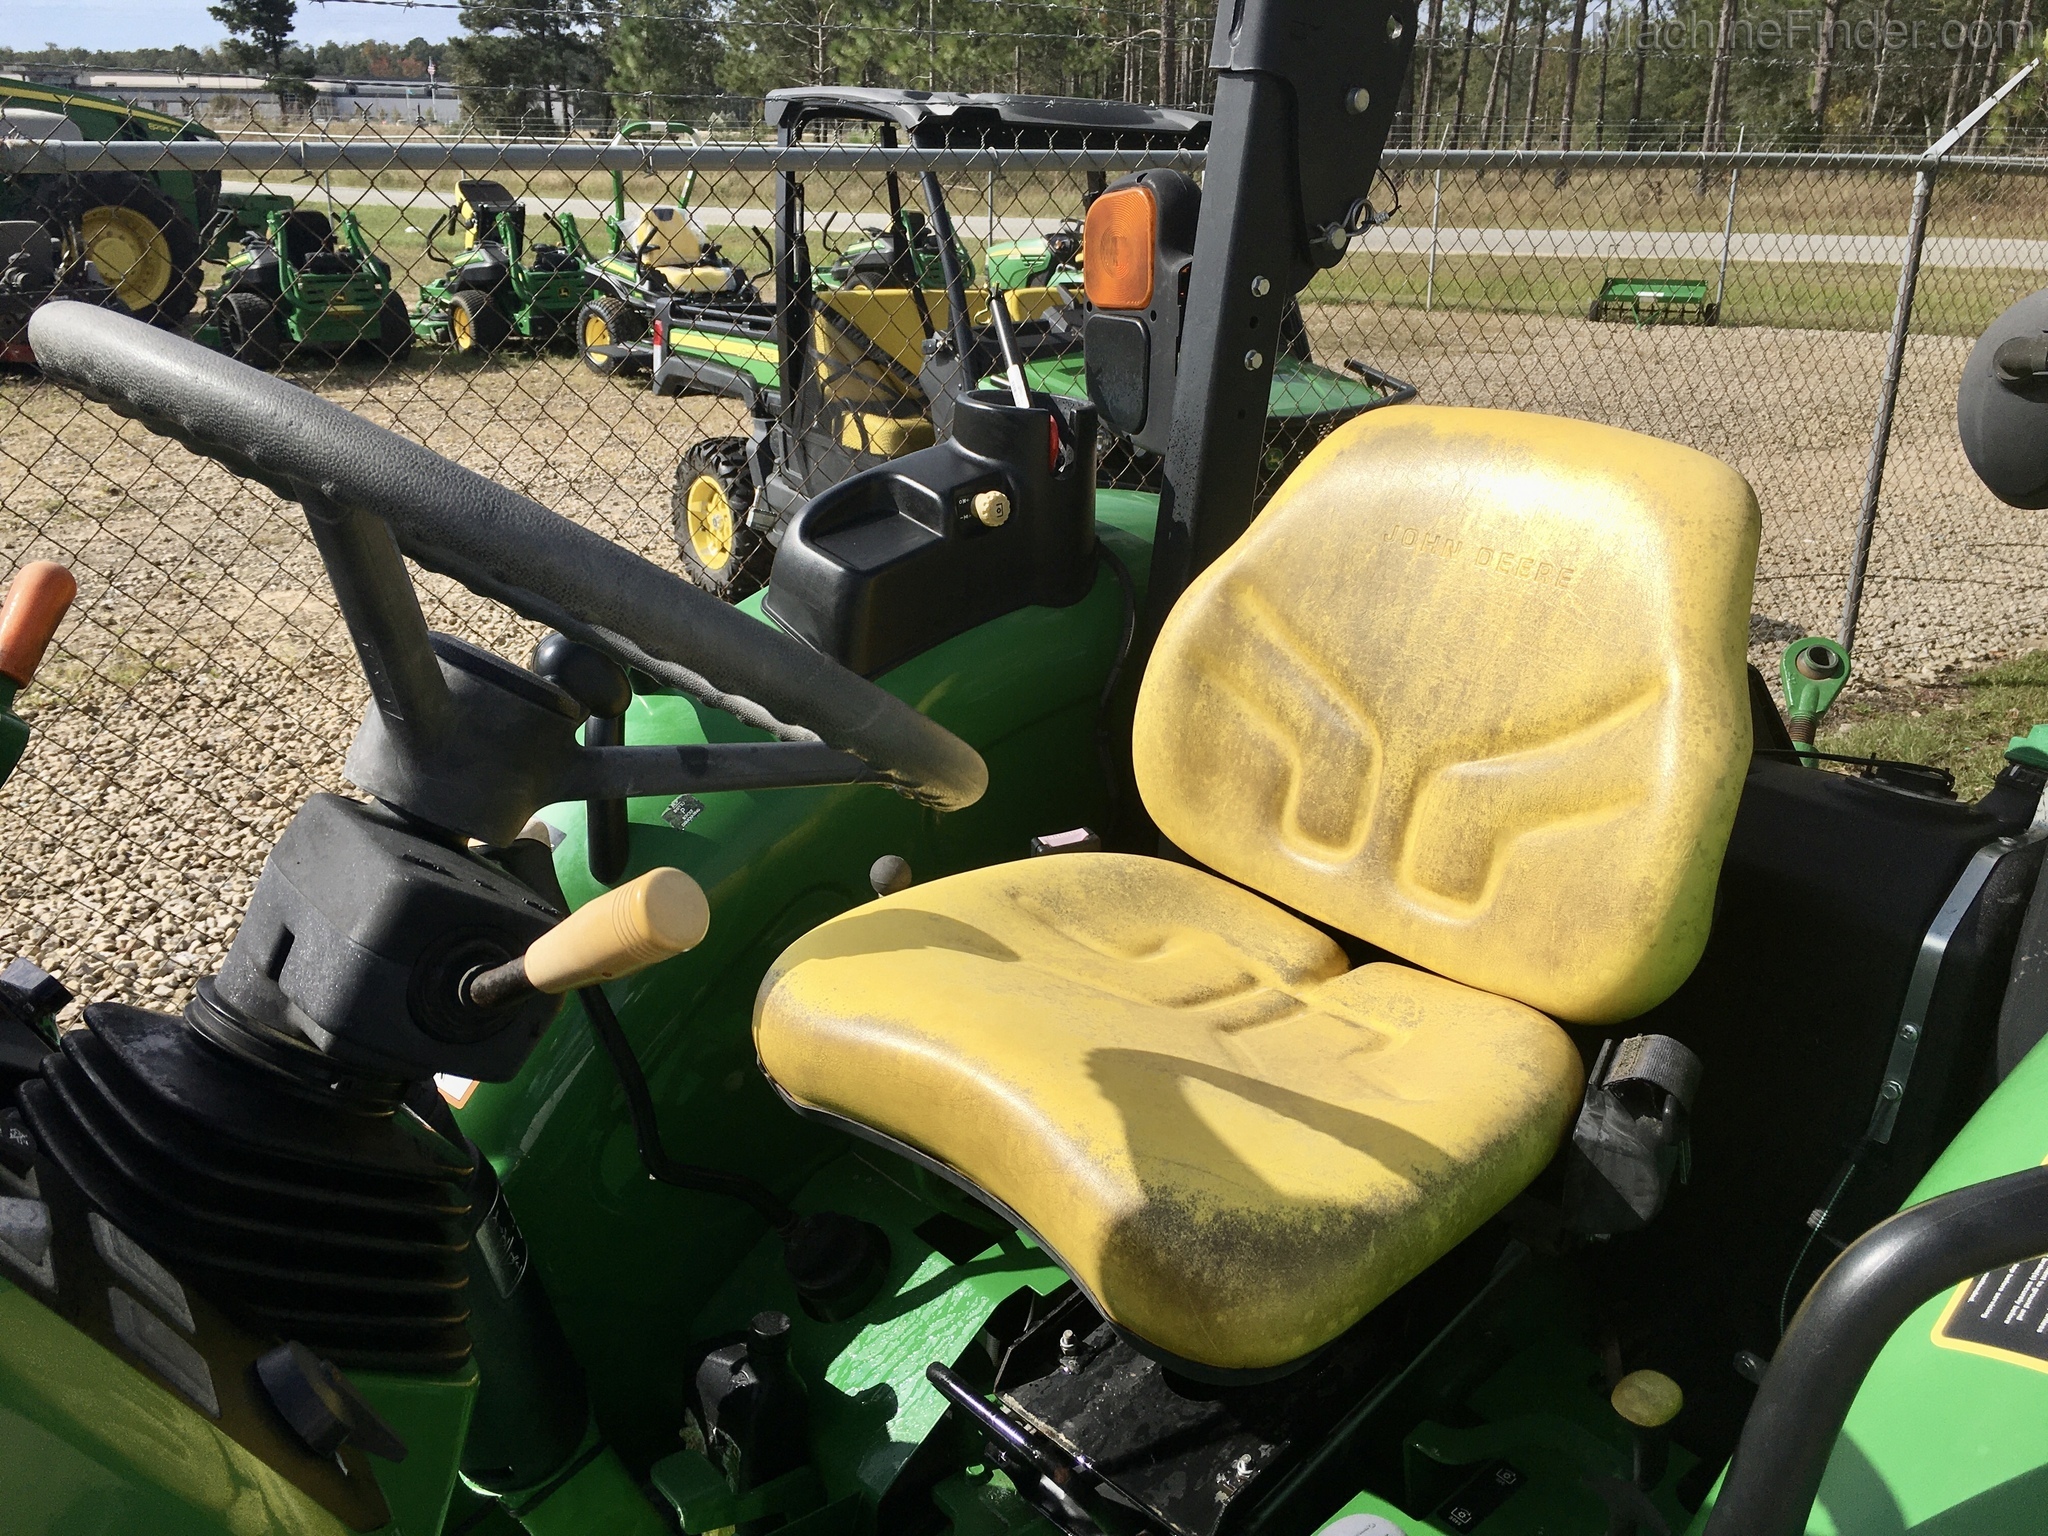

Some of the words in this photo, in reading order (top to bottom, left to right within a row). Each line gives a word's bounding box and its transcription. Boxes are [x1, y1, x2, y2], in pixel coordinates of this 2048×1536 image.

[1383, 524, 1463, 559] JOHN
[1474, 546, 1575, 588] DEERE
[1998, 1273, 2014, 1292] before
[1980, 1291, 2001, 1319] servicing
[2003, 1305, 2020, 1325] before
